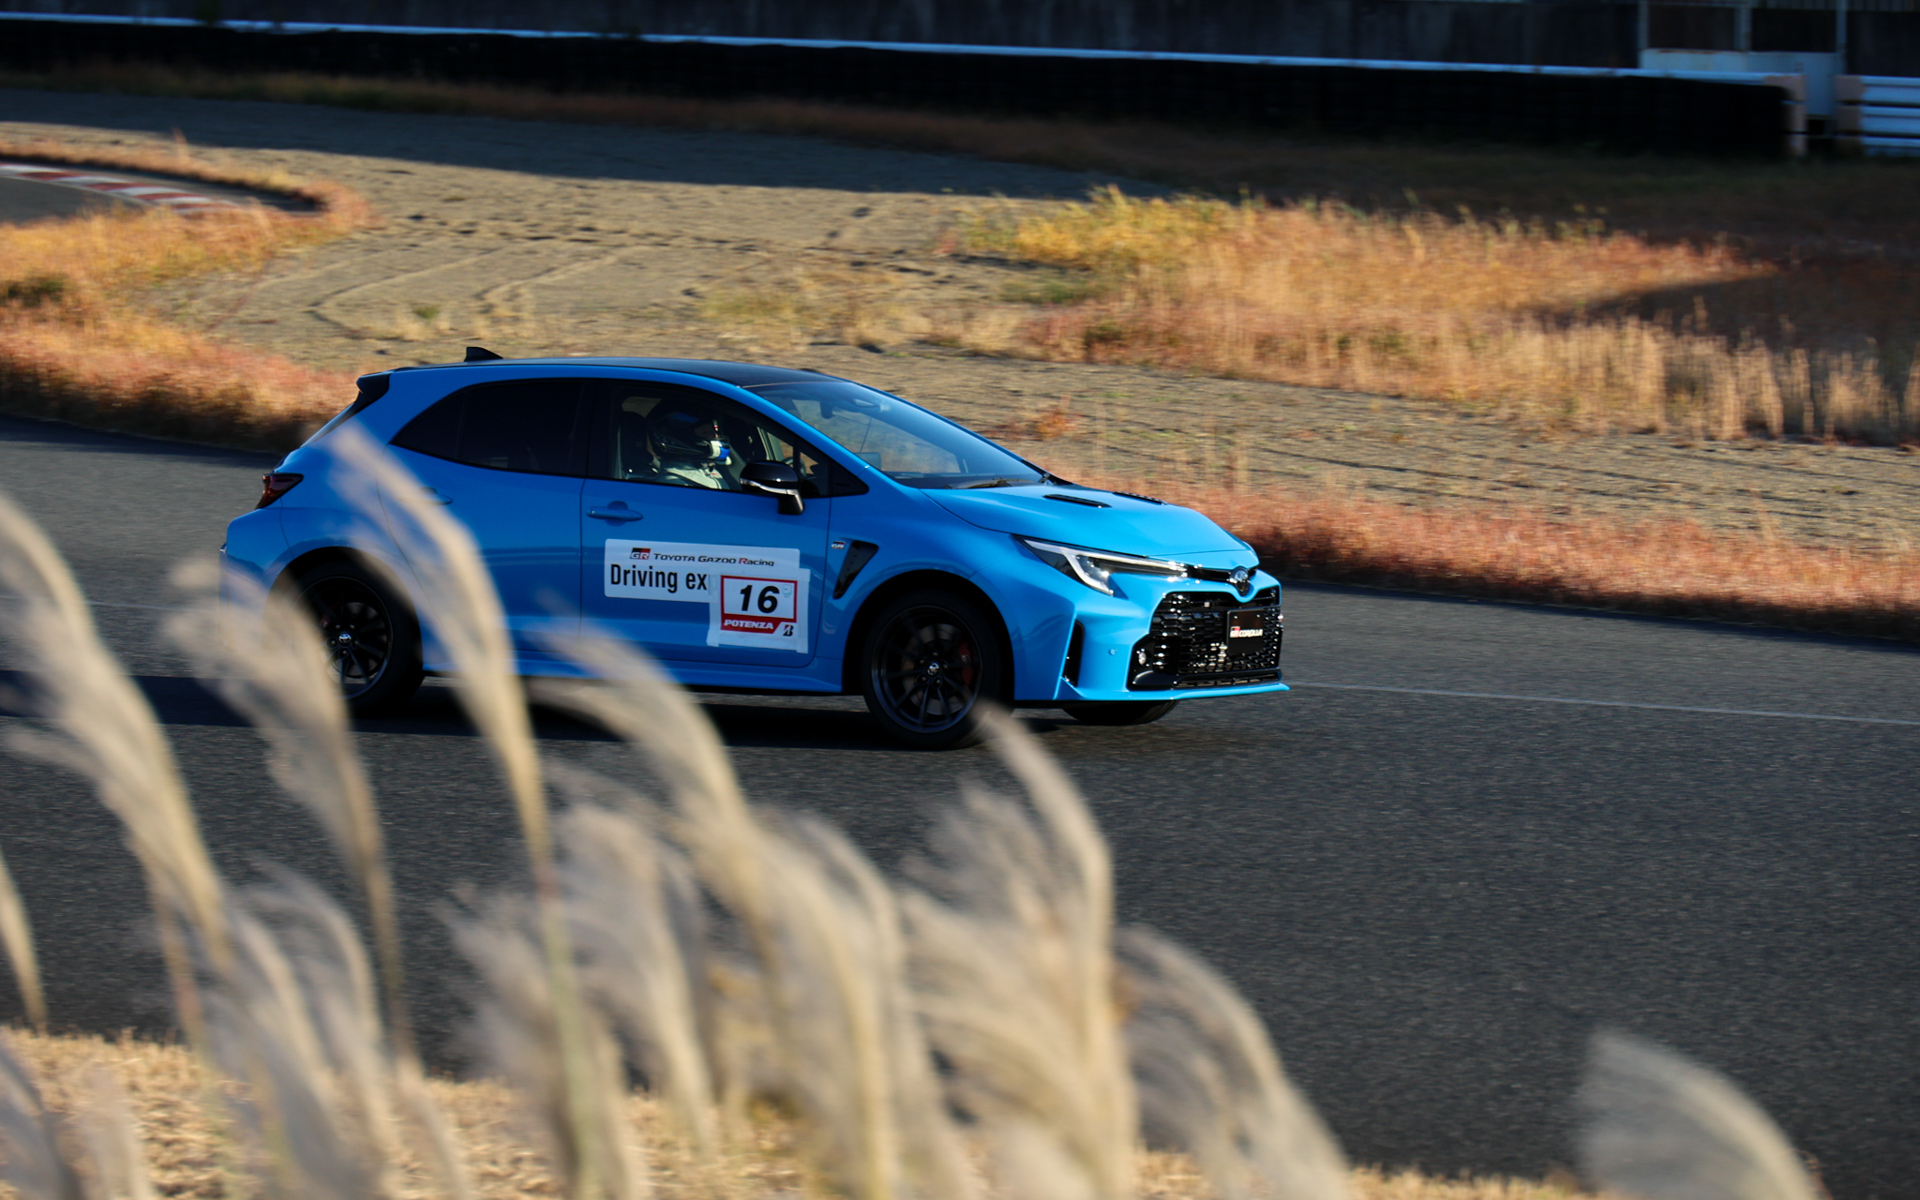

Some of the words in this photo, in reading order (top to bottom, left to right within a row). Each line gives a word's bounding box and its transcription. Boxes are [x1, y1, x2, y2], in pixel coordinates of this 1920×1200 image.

[630, 550, 651, 560] GR
[653, 552, 695, 562] TOYOTA
[697, 555, 736, 564] GAZOO
[738, 557, 775, 566] Racing
[611, 564, 678, 593] Driving
[740, 584, 780, 614] 16
[723, 619, 774, 630] POTENZA
